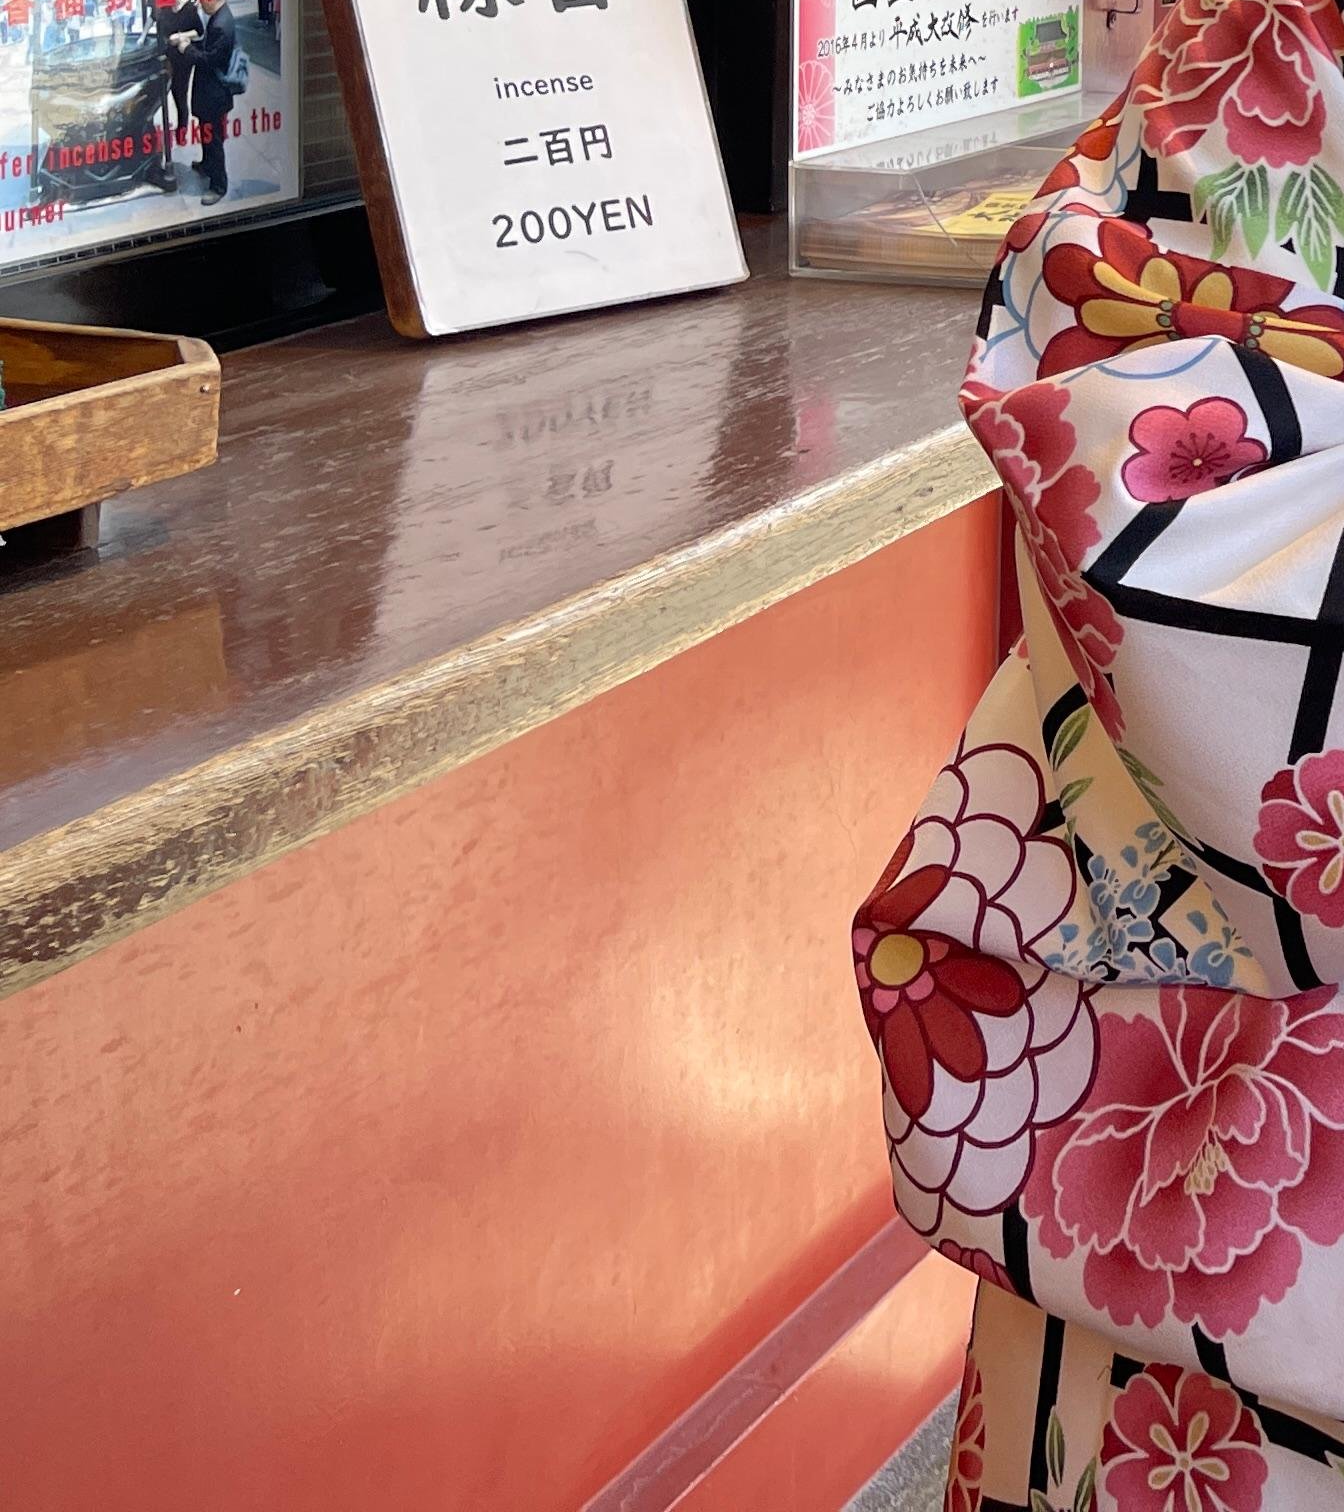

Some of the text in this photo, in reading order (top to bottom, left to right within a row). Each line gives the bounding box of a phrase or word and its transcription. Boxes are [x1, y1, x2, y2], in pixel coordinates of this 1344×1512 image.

[494, 71, 595, 100] incense
[866, 77, 999, 122] ご協力よろしくお願い致します
[51, 134, 134, 171] incense
[142, 118, 213, 155] sticks
[221, 116, 242, 139] to
[251, 108, 283, 135] the
[502, 123, 613, 167] 二百円
[491, 194, 654, 250] 200YEN
